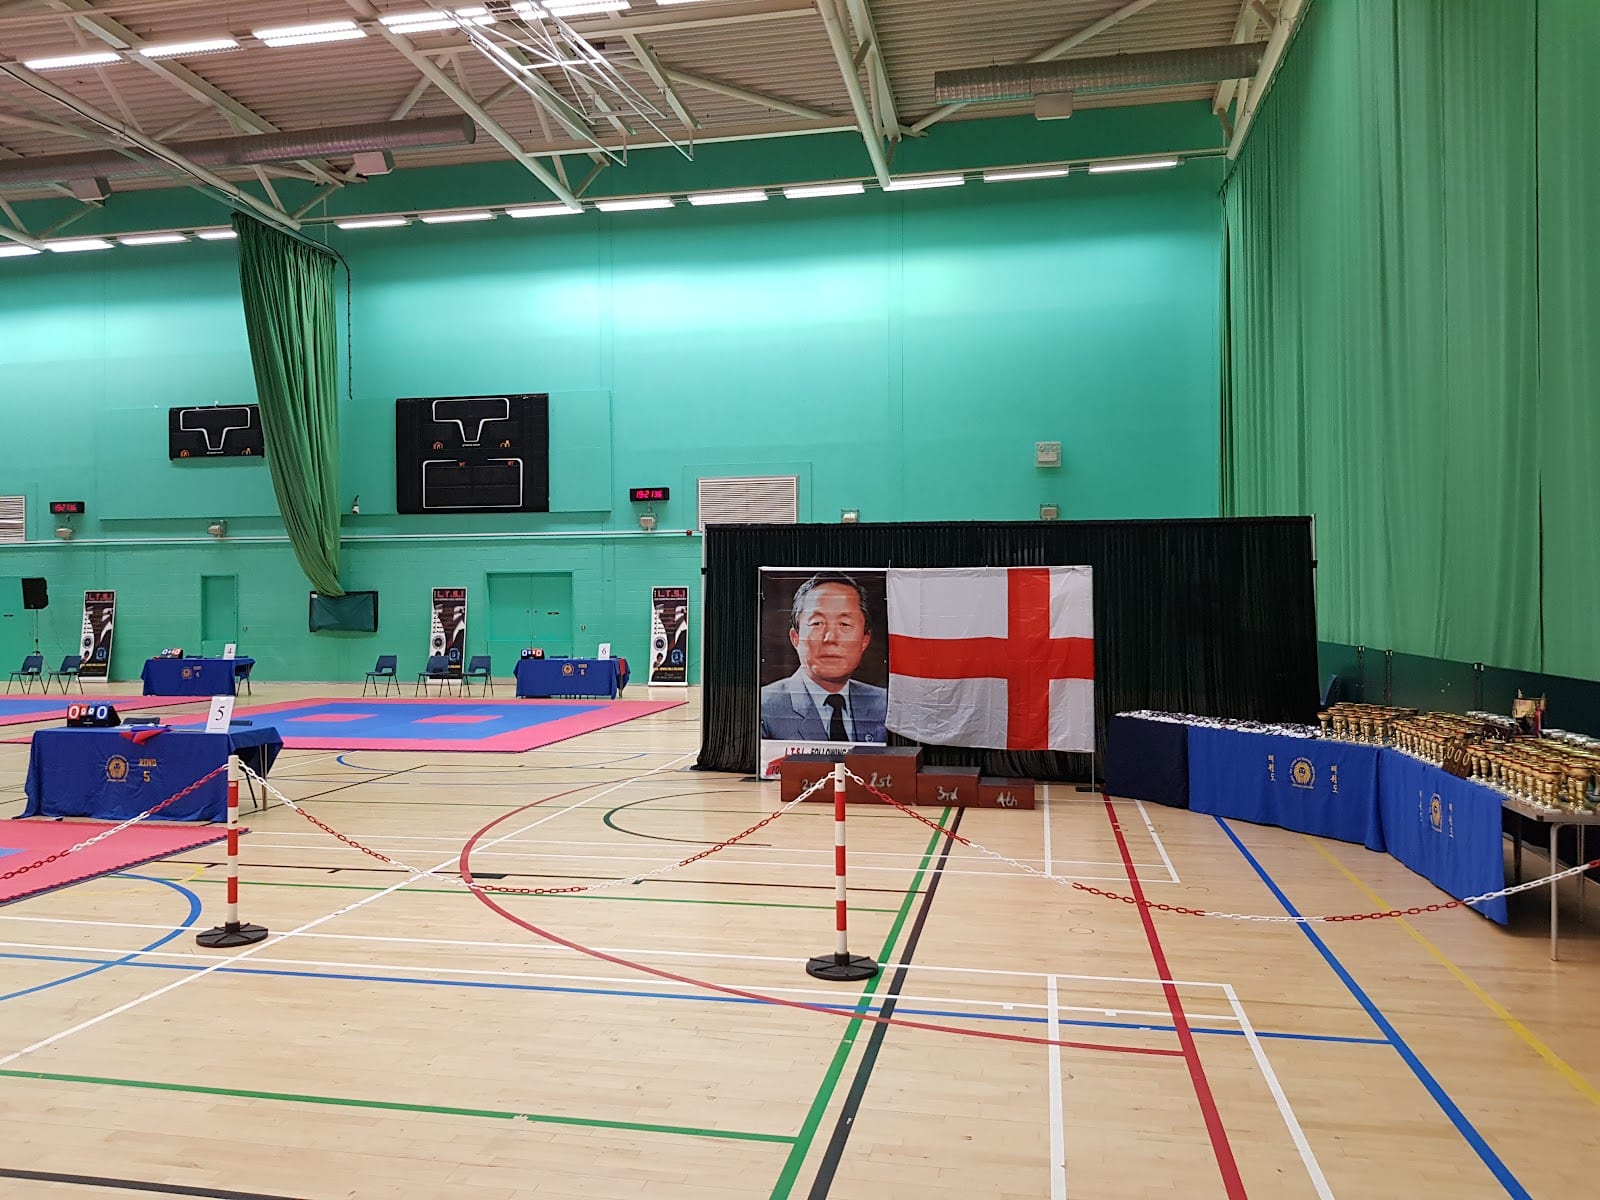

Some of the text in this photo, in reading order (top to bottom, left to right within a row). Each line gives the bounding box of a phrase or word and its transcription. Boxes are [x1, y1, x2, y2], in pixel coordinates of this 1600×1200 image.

[601, 647, 607, 655] 6
[69, 705, 80, 719] 0
[97, 705, 108, 720] 0
[215, 705, 226, 721] 5
[143, 770, 151, 782] 5
[936, 785, 958, 801] 3rd
[996, 791, 1018, 807] 4th
